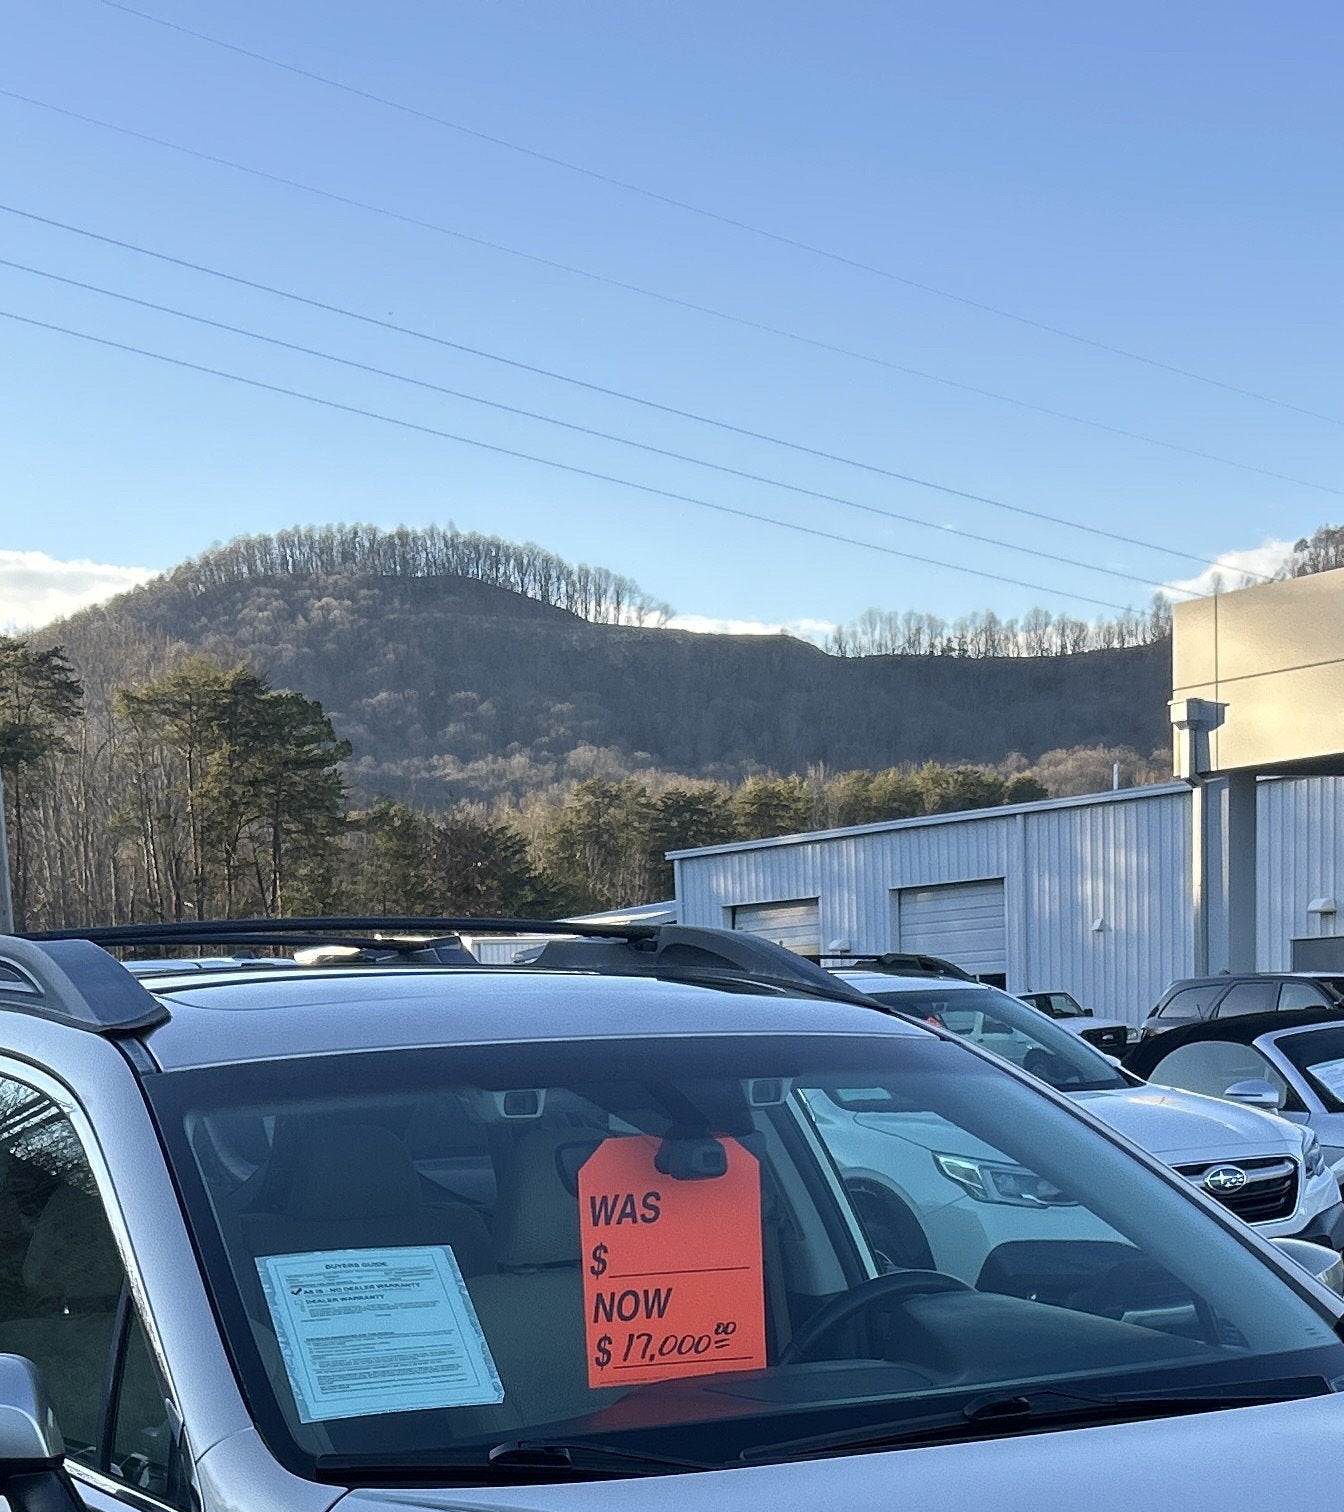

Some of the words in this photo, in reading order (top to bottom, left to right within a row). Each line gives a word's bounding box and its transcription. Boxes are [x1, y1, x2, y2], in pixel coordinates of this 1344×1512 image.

[589, 1191, 661, 1227] WAS
[590, 1242, 609, 1280] $
[306, 1297, 340, 1305] DEALER
[341, 1294, 385, 1302] WARRANTY
[343, 1284, 375, 1292] DEALER
[593, 1287, 673, 1324] NOW
[595, 1332, 613, 1371] $
